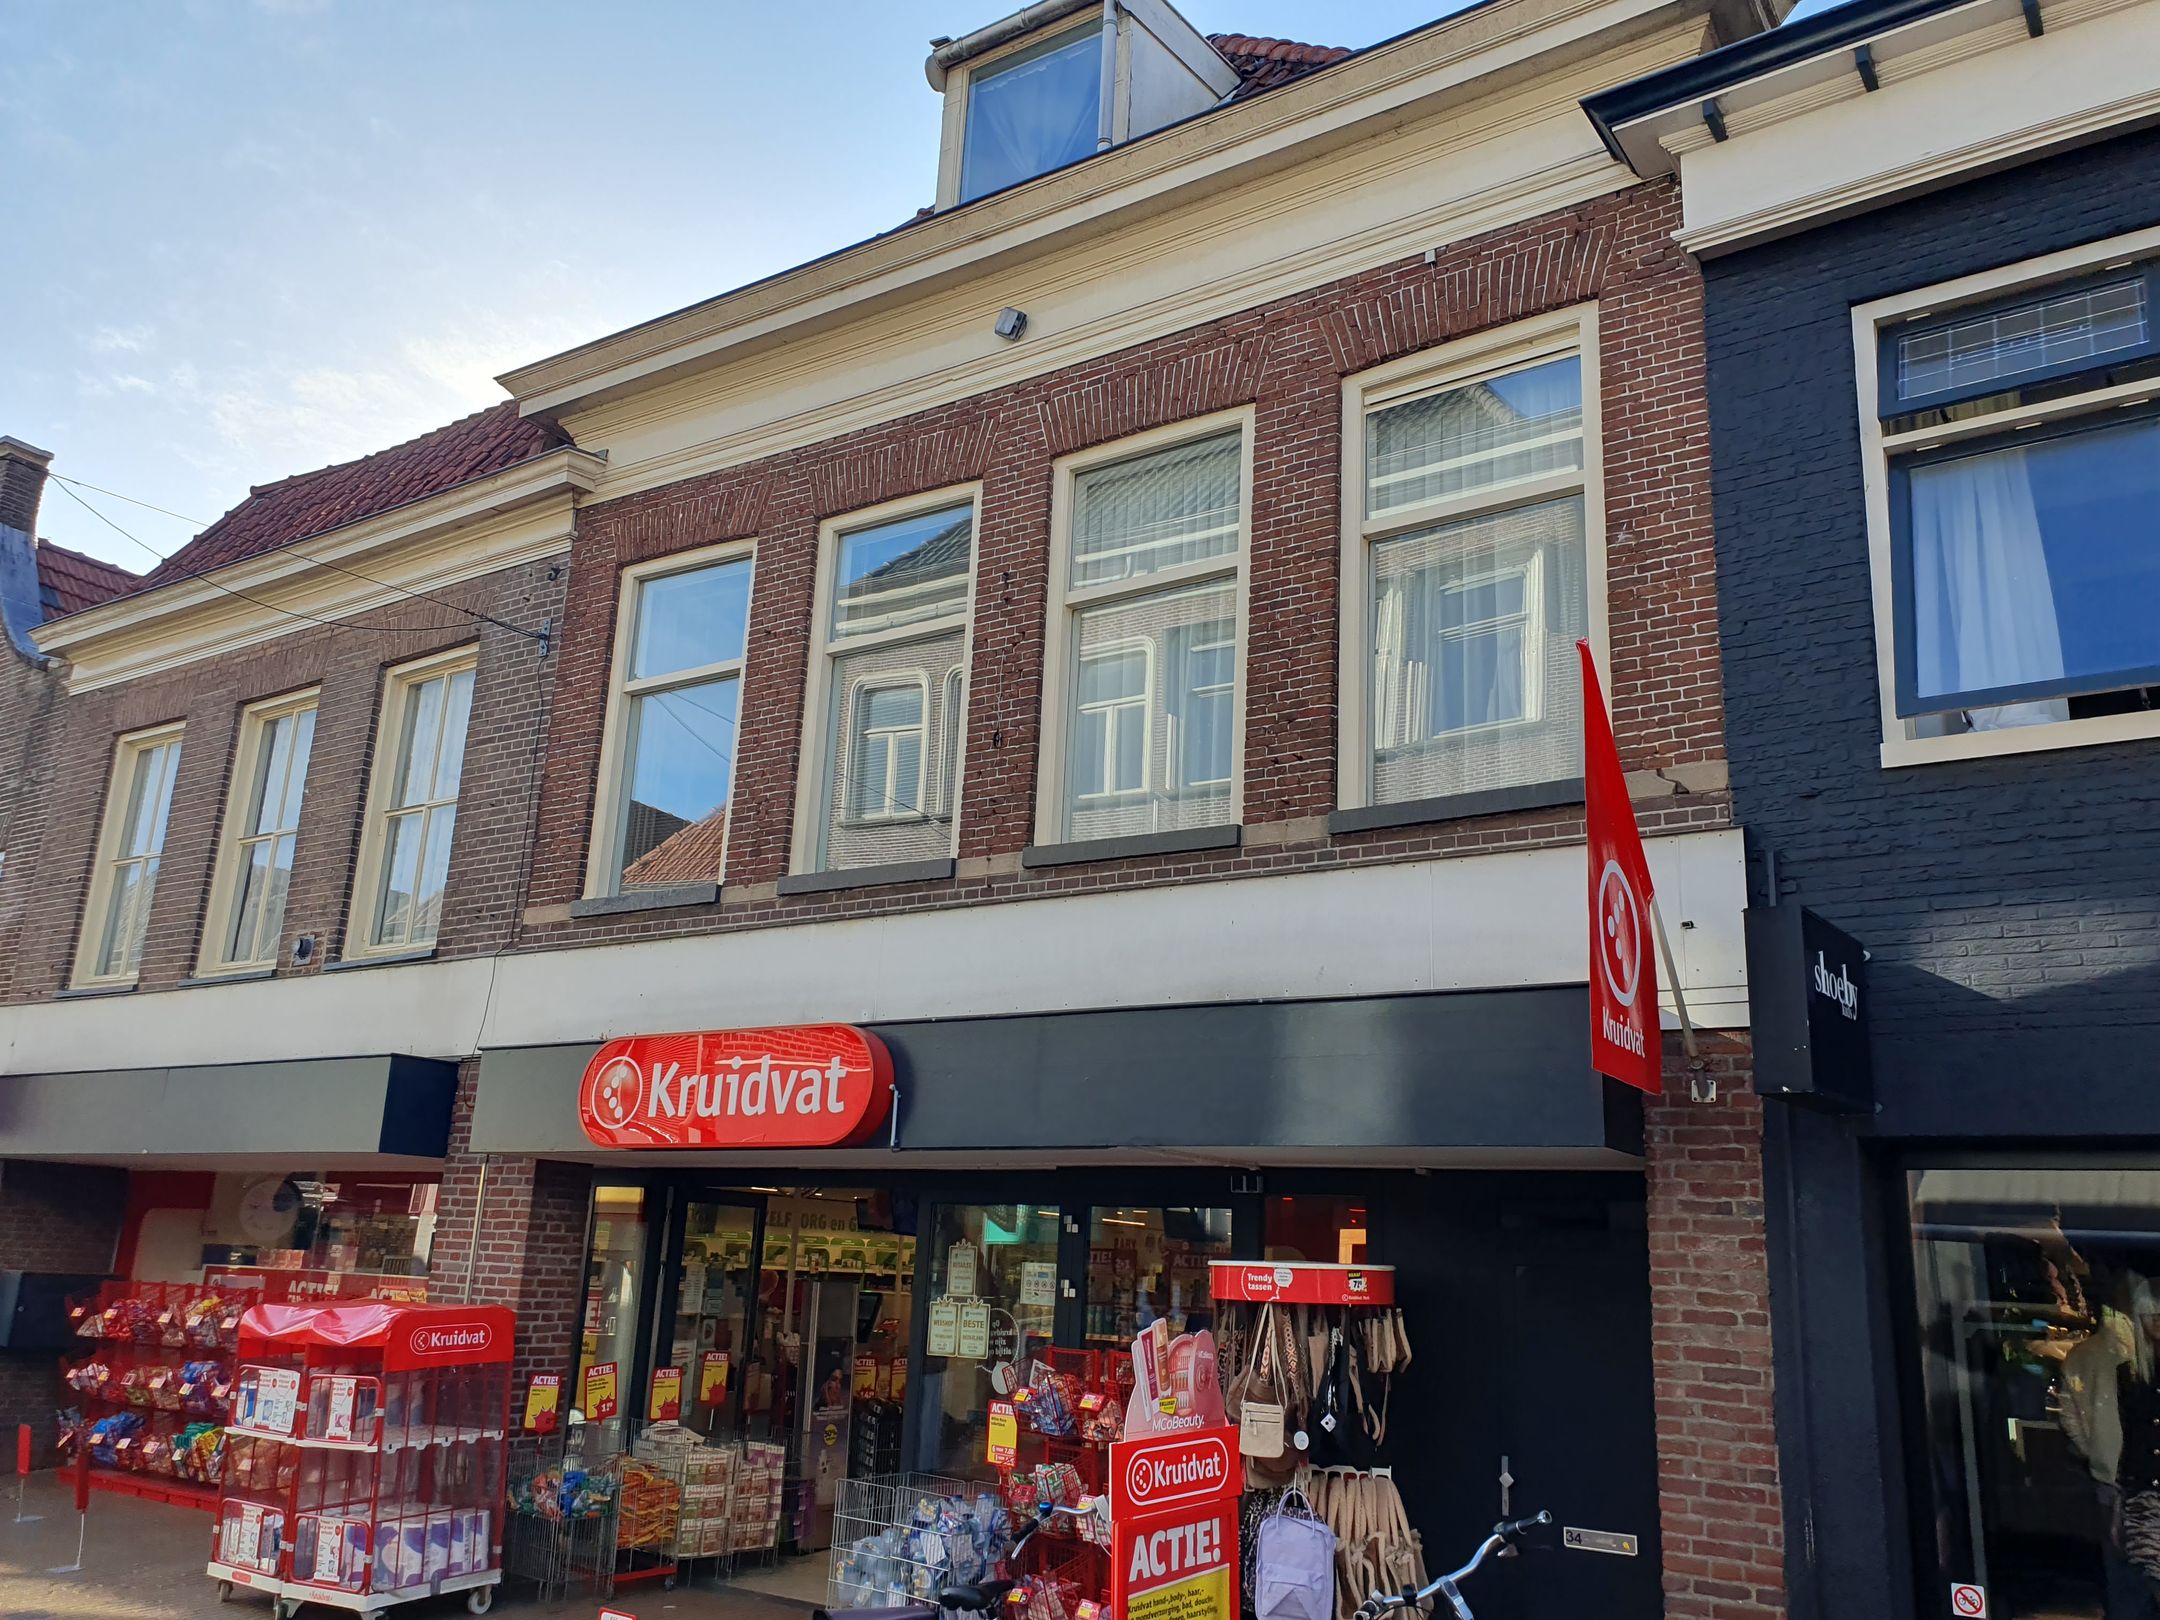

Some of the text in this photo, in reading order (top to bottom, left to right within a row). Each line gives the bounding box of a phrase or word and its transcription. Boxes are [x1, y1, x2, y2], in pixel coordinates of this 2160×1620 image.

[1814, 950, 1858, 1021] shoeby
[1602, 1006, 1646, 1058] Kruidvat
[647, 1054, 848, 1118] Kruidvat
[1247, 1273, 1273, 1283] Trendy
[1248, 1283, 1273, 1291] tassen
[963, 1319, 985, 1329] BESTE
[431, 1330, 485, 1347] Kruidvat
[706, 1352, 728, 1361] ACTIE!
[588, 1364, 613, 1377] ACTIE!
[656, 1368, 680, 1378] ACTIE!
[532, 1375, 559, 1386] ACTIE!
[1154, 1451, 1222, 1488] Kruidvat
[1566, 1530, 1583, 1545] 34
[1129, 1517, 1221, 1583] ACTIE!
[1128, 1600, 1153, 1613] Kruidvat
